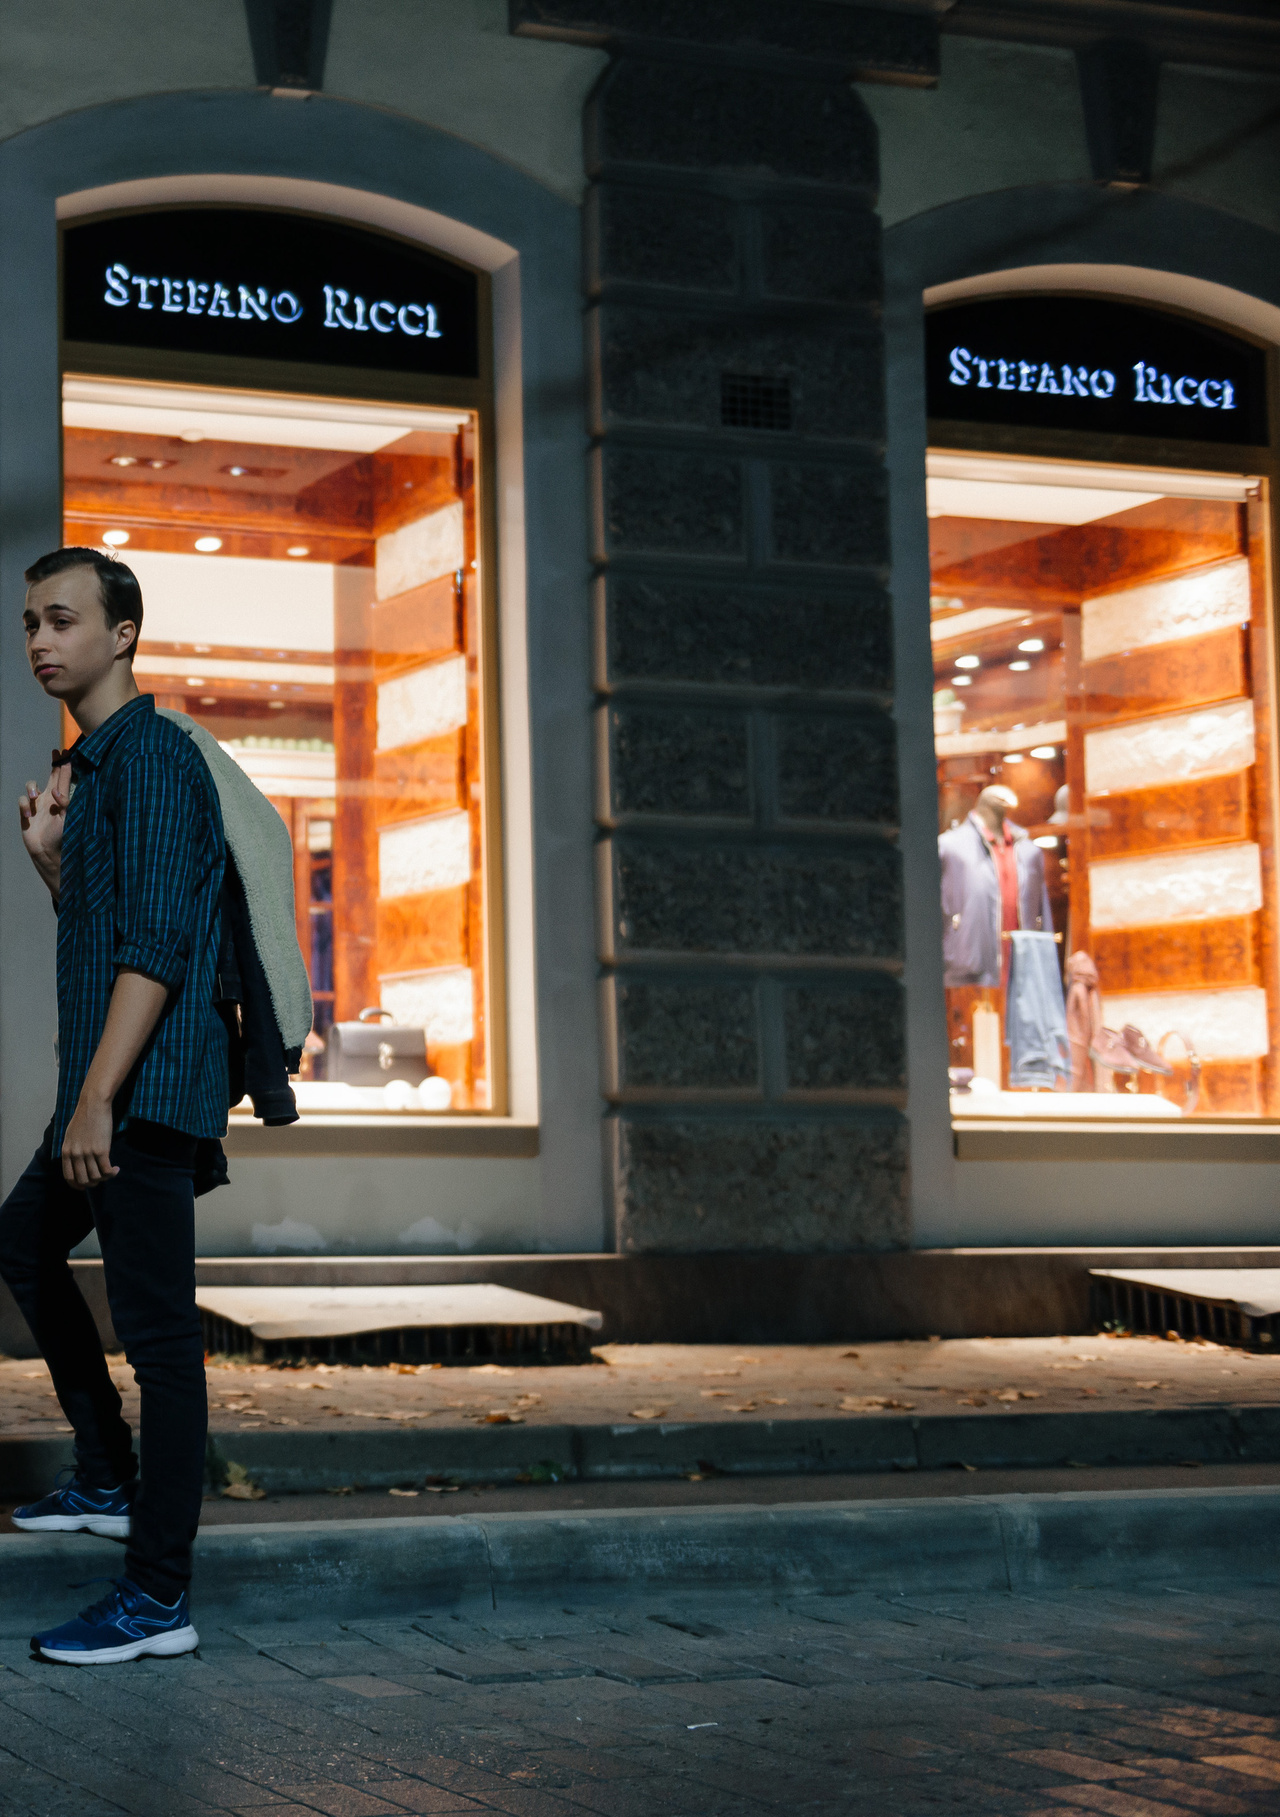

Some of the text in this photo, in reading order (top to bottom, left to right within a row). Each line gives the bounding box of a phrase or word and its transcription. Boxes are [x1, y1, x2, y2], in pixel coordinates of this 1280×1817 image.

[103, 263, 442, 339] STEFANO RICCI
[948, 346, 1236, 410] STEFANO RICCI
